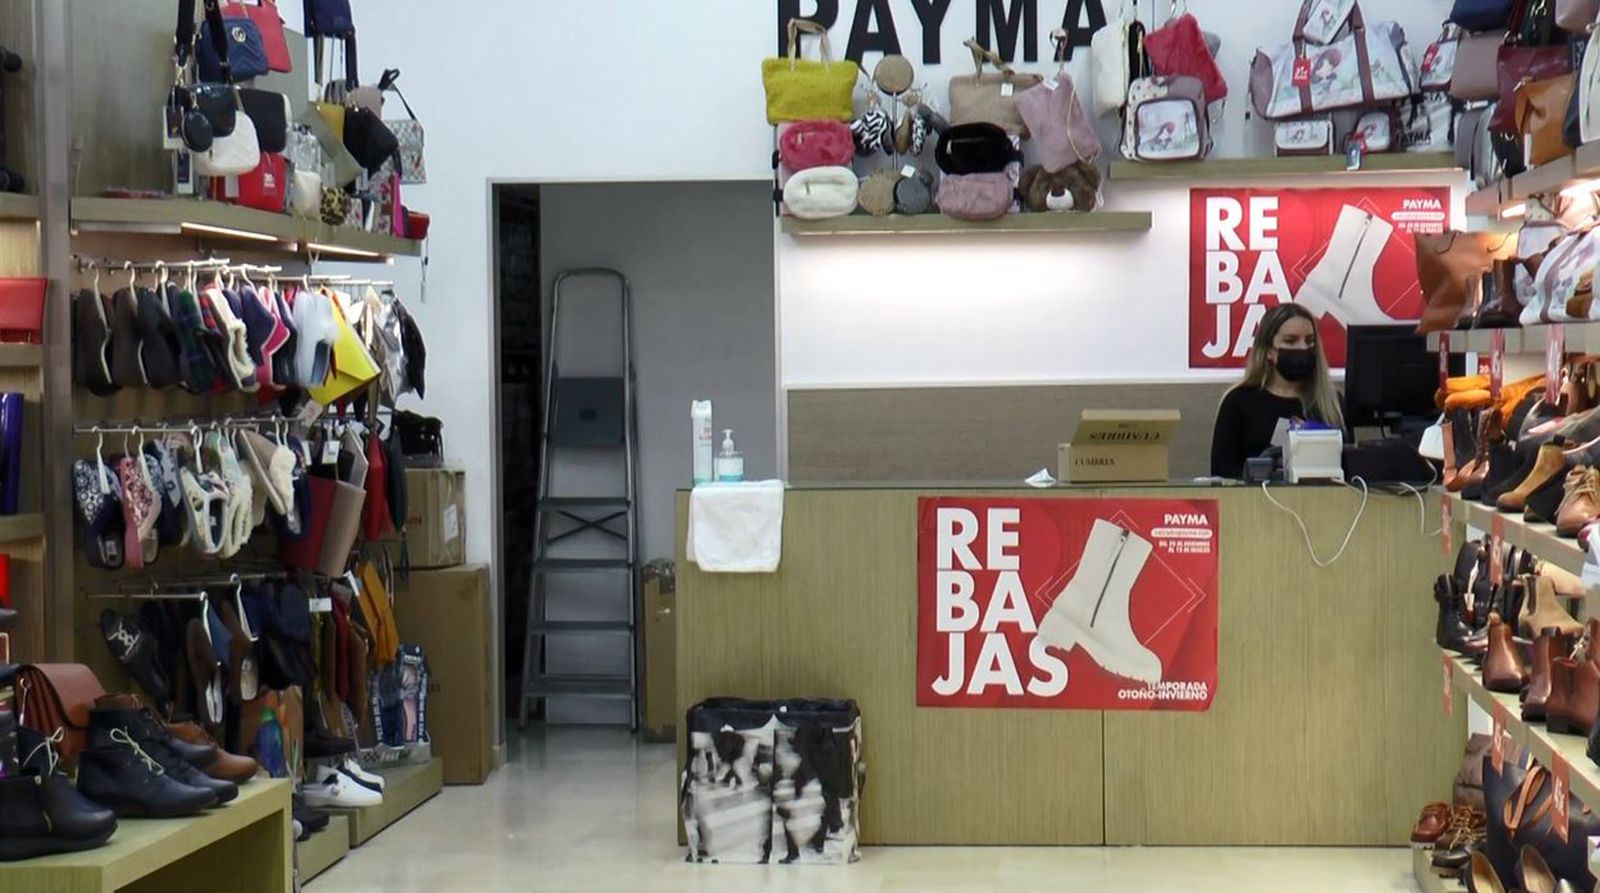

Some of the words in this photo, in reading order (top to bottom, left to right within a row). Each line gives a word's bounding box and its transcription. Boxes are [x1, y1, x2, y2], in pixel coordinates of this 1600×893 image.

[778, 0, 1107, 65] PAYMA
[1206, 196, 1279, 250] RE
[1403, 199, 1442, 210] PAYMA
[1206, 250, 1293, 304] BA
[937, 508, 1020, 570] RE
[1164, 514, 1209, 525] PAYMA
[937, 571, 1037, 632] BA
[931, 632, 1069, 697] JAS
[1118, 687, 1208, 700] OTOÑO-INVIERNO
